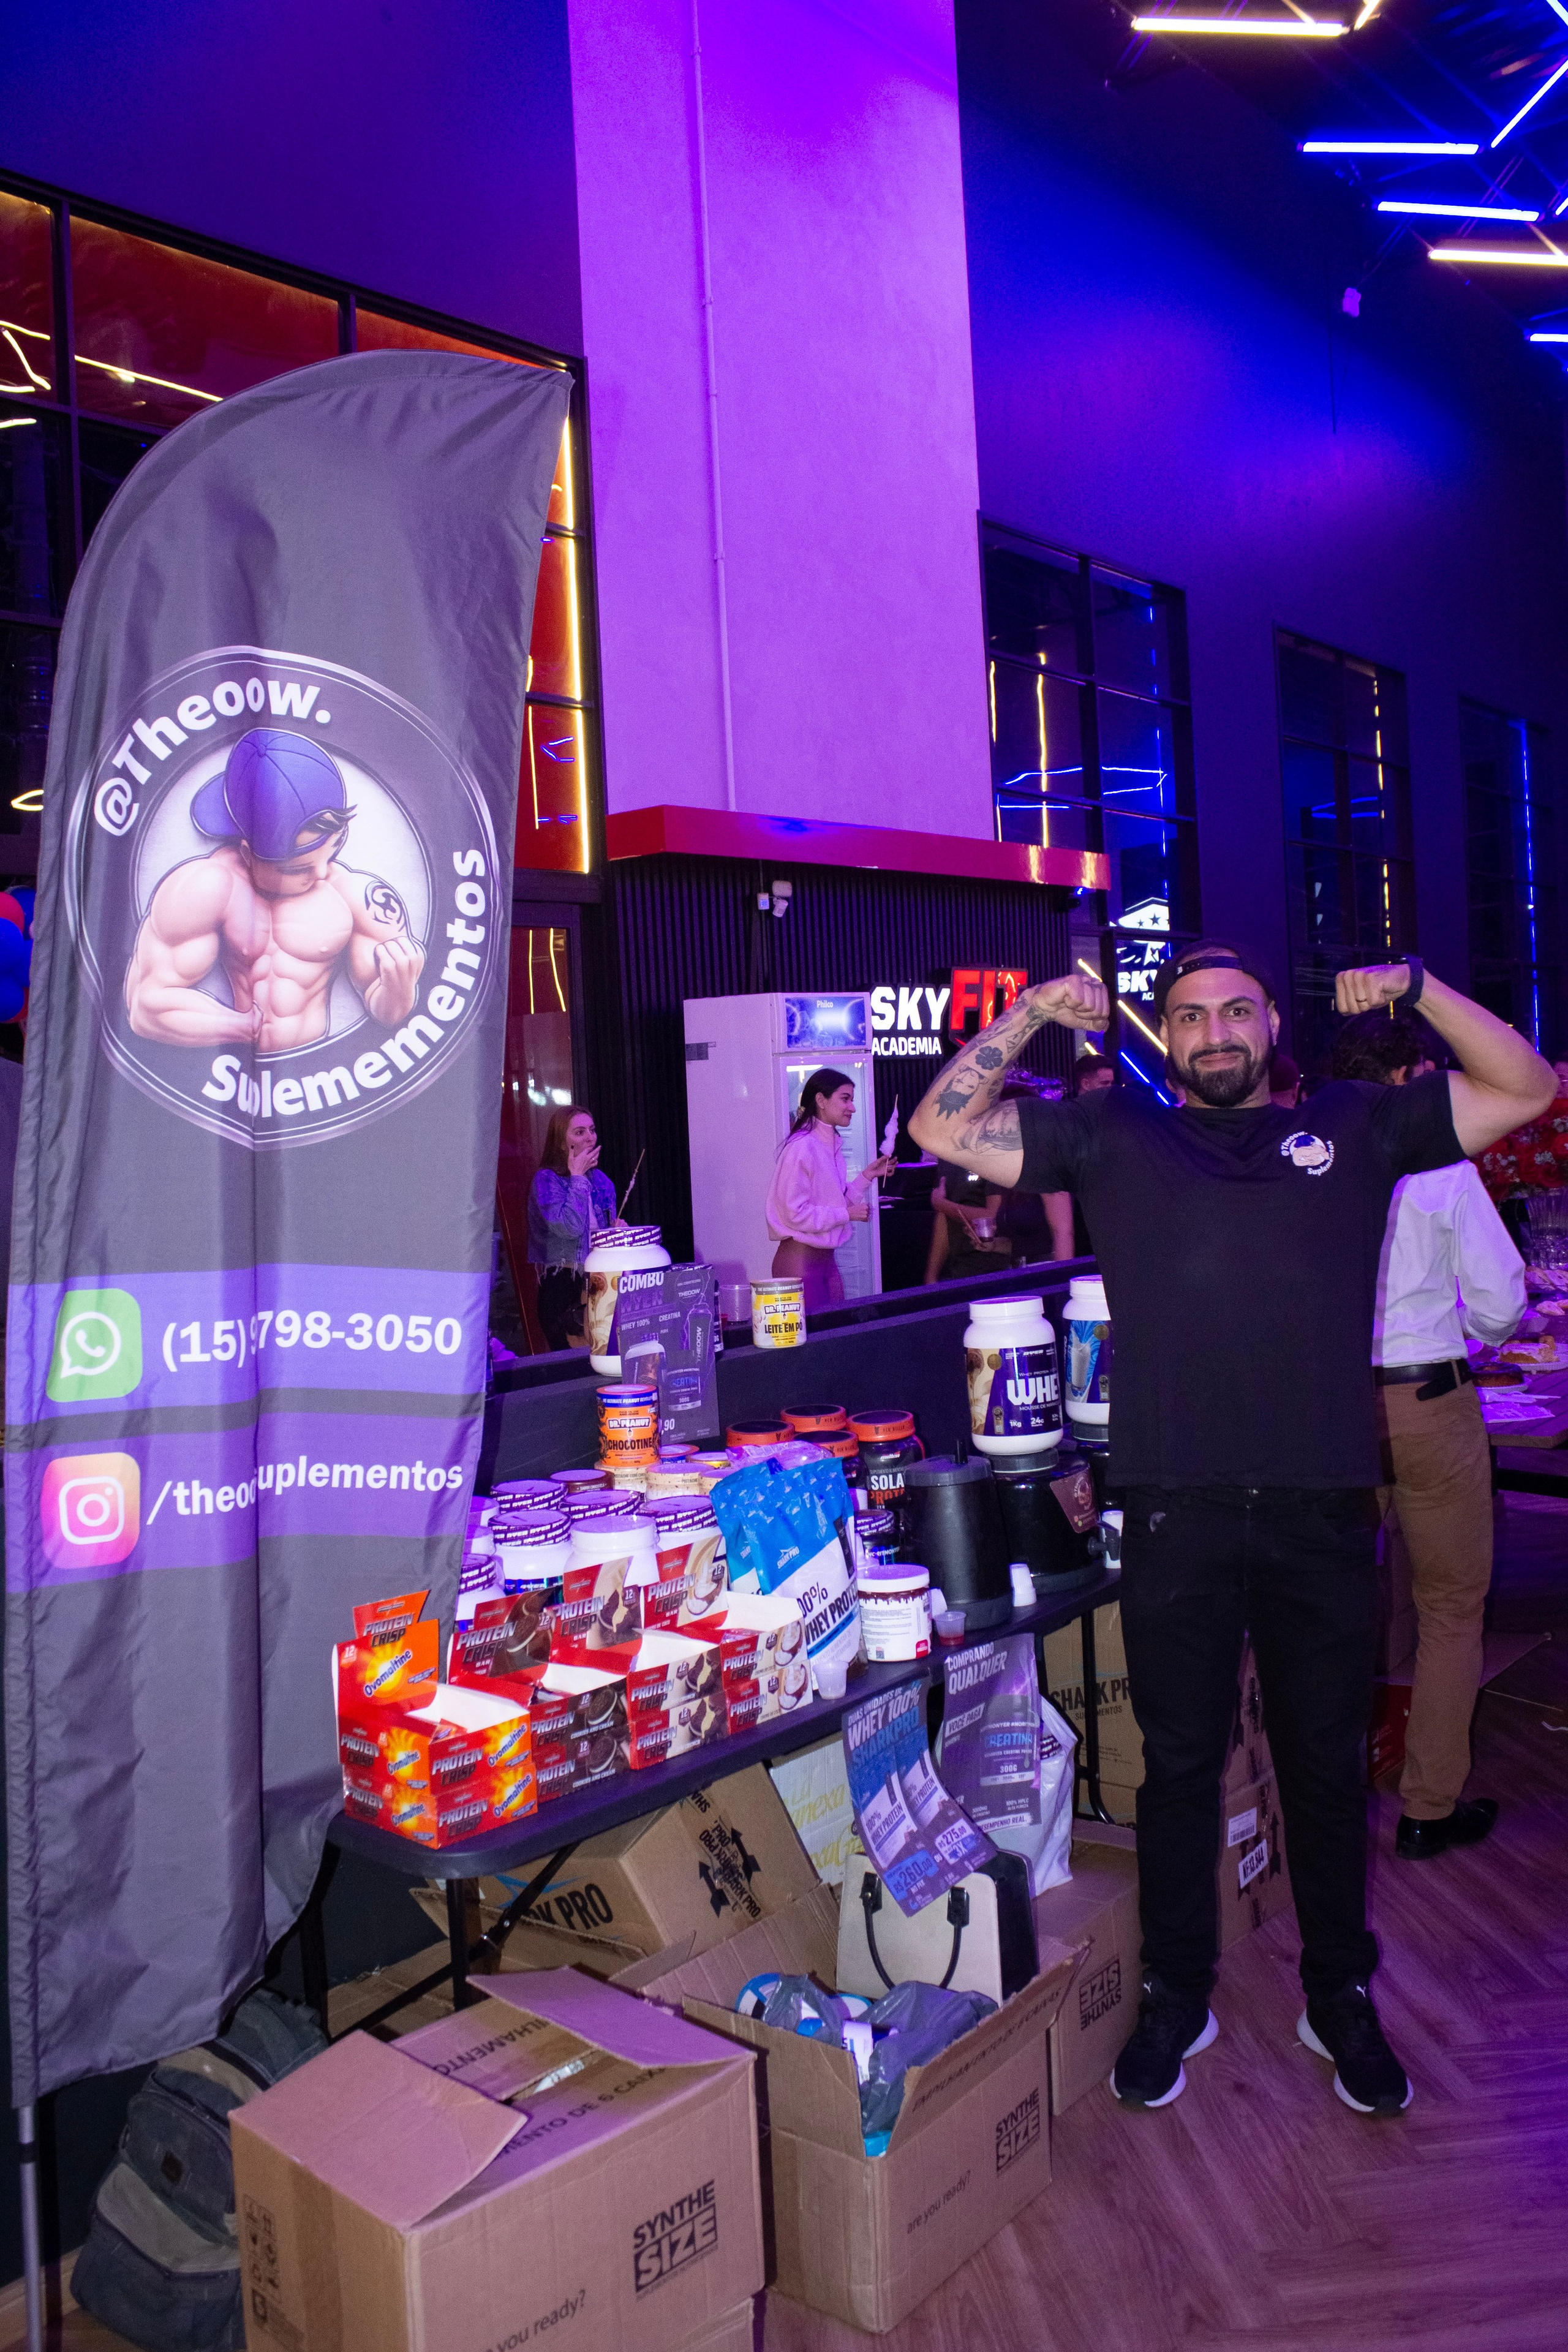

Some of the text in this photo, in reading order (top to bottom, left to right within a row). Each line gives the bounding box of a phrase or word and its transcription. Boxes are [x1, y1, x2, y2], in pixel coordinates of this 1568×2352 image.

[871, 987, 951, 1031] SKY
[872, 1037, 943, 1056] ACADEMIA
[1307, 1140, 1335, 1176] Suplementos
[659, 1311, 681, 1322] CREATINA
[776, 1303, 801, 1312] PEANUT
[621, 1317, 650, 1331] WHEY 100%
[764, 1324, 783, 1334] LEITE
[784, 1323, 794, 1333] EM
[162, 1319, 246, 1372] (15)
[620, 1417, 650, 1428] PEANUT
[661, 1419, 675, 1434] ,90
[608, 1437, 653, 1451] CHOCOTINE
[870, 1473, 905, 1491] SOLA
[714, 1564, 722, 1576] 12
[625, 1589, 635, 1600] 12
[647, 1573, 696, 1603] PROTEIN
[797, 1581, 828, 1618] 00%
[553, 1595, 605, 1621] PROTEIN
[655, 1590, 688, 1615] CRISP
[363, 1613, 415, 1636] PROTEIN
[456, 1621, 518, 1651] PROTEIN
[561, 1613, 598, 1637] CRISP
[371, 1628, 407, 1648] CRISP
[463, 1640, 504, 1664] CRISP
[475, 1660, 491, 1668] BAR
[723, 1649, 764, 1672] PROTEIN
[948, 1642, 994, 1671] COMPRANDO
[364, 1649, 413, 1697] Ovomaltine
[731, 1662, 758, 1680] CRISP
[948, 1651, 1008, 1695] QUALQUER
[631, 1679, 674, 1702] PROTEIN
[638, 1691, 668, 1711] CRISP
[864, 1690, 894, 1715] UNIDADES
[1050, 1677, 1130, 1711] SHAK PR
[730, 1694, 767, 1717] PROTEIN
[736, 1707, 763, 1726] CRISP
[848, 1683, 922, 1751] WHEY 100%
[1074, 1705, 1123, 1721] SUMENTOS
[530, 1711, 575, 1734] PROTEIN
[341, 1733, 380, 1758] PROTEIN
[488, 1723, 527, 1767] Ovomaltine
[579, 1741, 589, 1752] 12
[636, 1725, 677, 1750] PROTEIN
[432, 1747, 484, 1776] PROTEIN
[644, 1740, 672, 1760] CRISP
[387, 1749, 421, 1776] Ovomaltine
[1000, 1764, 1017, 1773] 300G
[440, 1763, 477, 1787] CRISP
[493, 1773, 532, 1817] Ovomaltine
[691, 1790, 710, 1814] SHA
[391, 1803, 425, 1827] Ovomaltine
[439, 1798, 489, 1828] PROTEIN
[883, 1801, 904, 1833] PROTEIN
[980, 1818, 1011, 1831] ESEMPENHO
[447, 1814, 483, 1838] CRISP
[553, 1883, 613, 1931] PRO
[995, 2087, 1039, 2140] SYNTHE
[996, 2104, 1040, 2173] SIZE
[633, 2178, 715, 2249] SYNTHE
[924, 2199, 941, 2225] you
[633, 2203, 718, 2293] SIZE
[496, 2288, 586, 2352] you ready?
